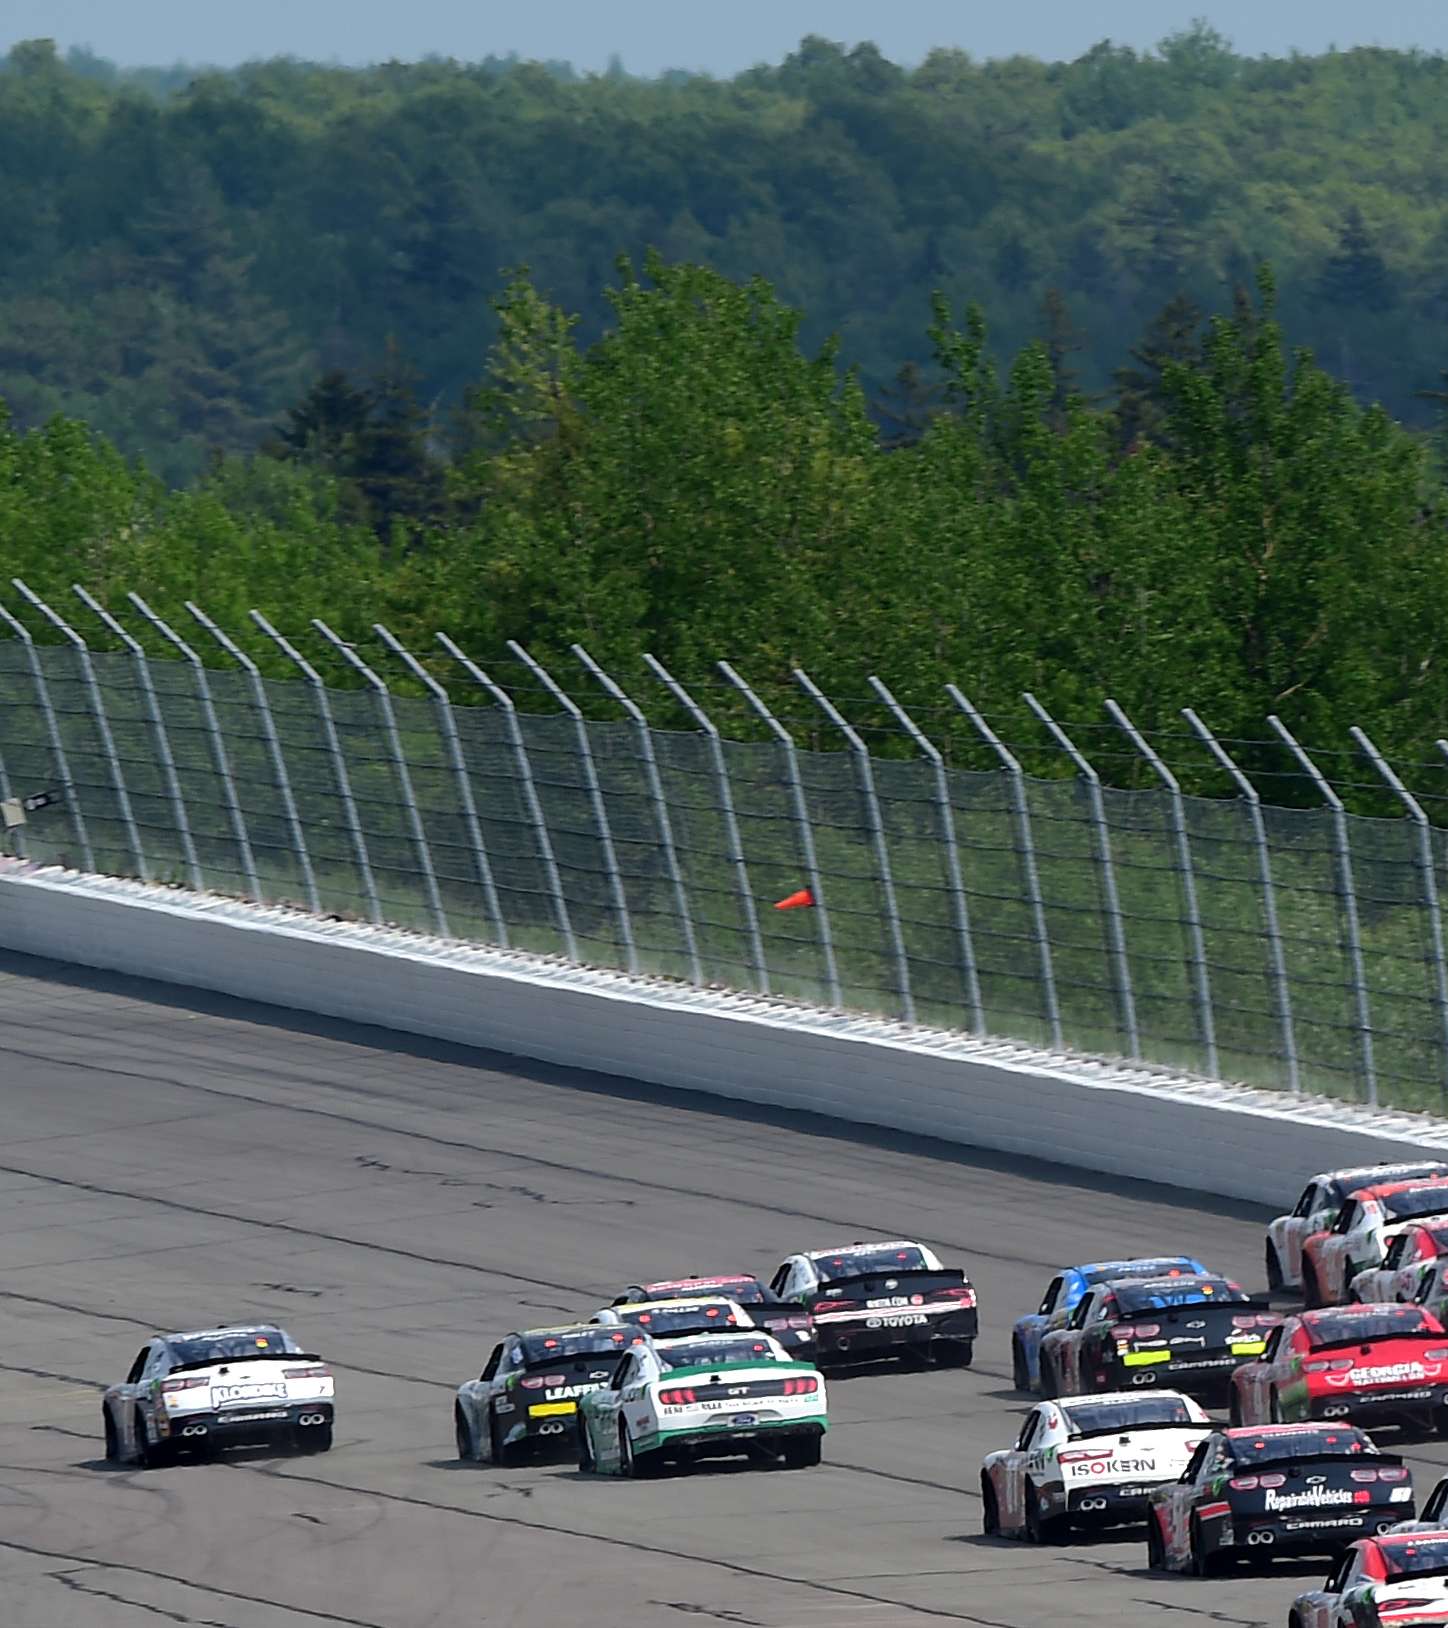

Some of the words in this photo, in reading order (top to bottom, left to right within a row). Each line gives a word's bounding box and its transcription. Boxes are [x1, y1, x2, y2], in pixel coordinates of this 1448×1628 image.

[882, 1314, 928, 1327] TOYOTA
[1350, 1361, 1424, 1380] GEORGIA
[1072, 1459, 1156, 1476] ISOKERN
[1286, 1517, 1363, 1530] CAMARO
